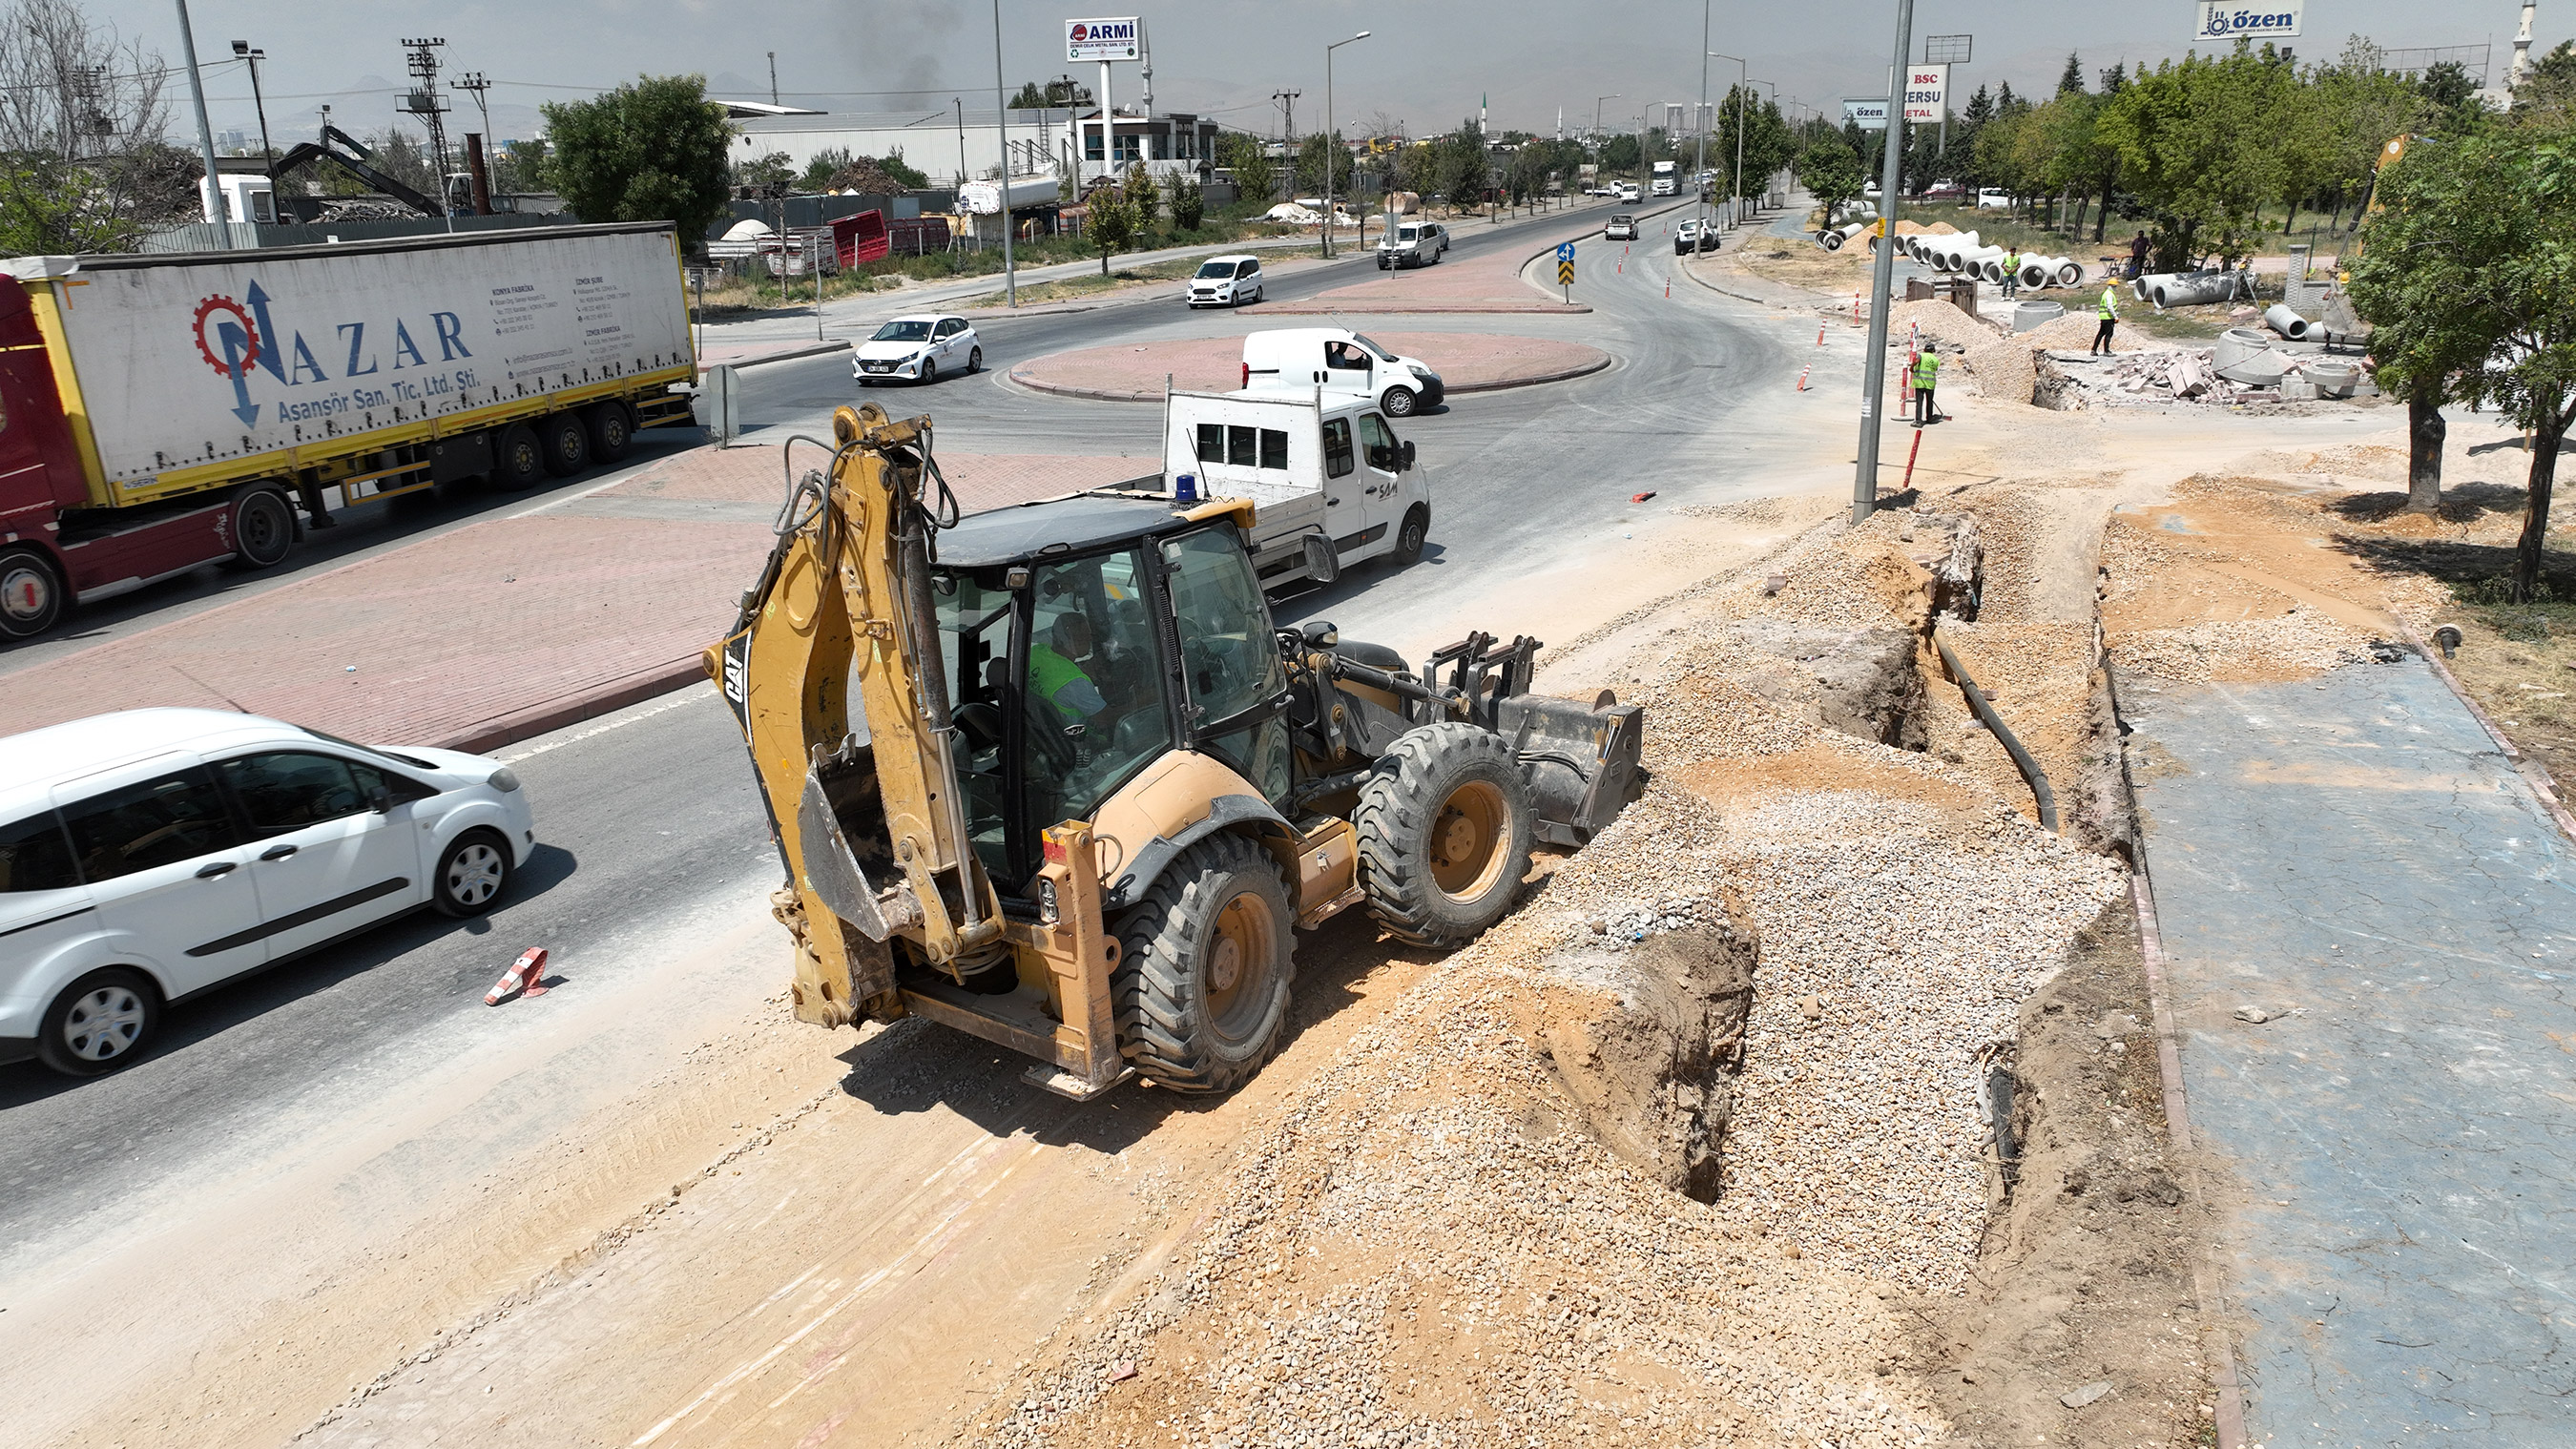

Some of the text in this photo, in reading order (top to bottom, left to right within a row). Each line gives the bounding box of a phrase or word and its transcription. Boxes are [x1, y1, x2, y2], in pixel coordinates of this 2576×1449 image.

[2233, 10, 2293, 29] özen
[1090, 21, 1134, 39] ARMİ
[1914, 74, 1938, 84] BSC
[1857, 107, 1882, 116] özen
[1905, 109, 1933, 117] ETAL
[492, 283, 534, 296] KONYA FABRİKA
[279, 392, 349, 424] Asansör
[353, 388, 390, 409] San.
[391, 381, 422, 402] Tic.
[426, 373, 454, 397] Ltd.
[1379, 481, 1398, 499] SAM
[725, 649, 743, 704] CAT
